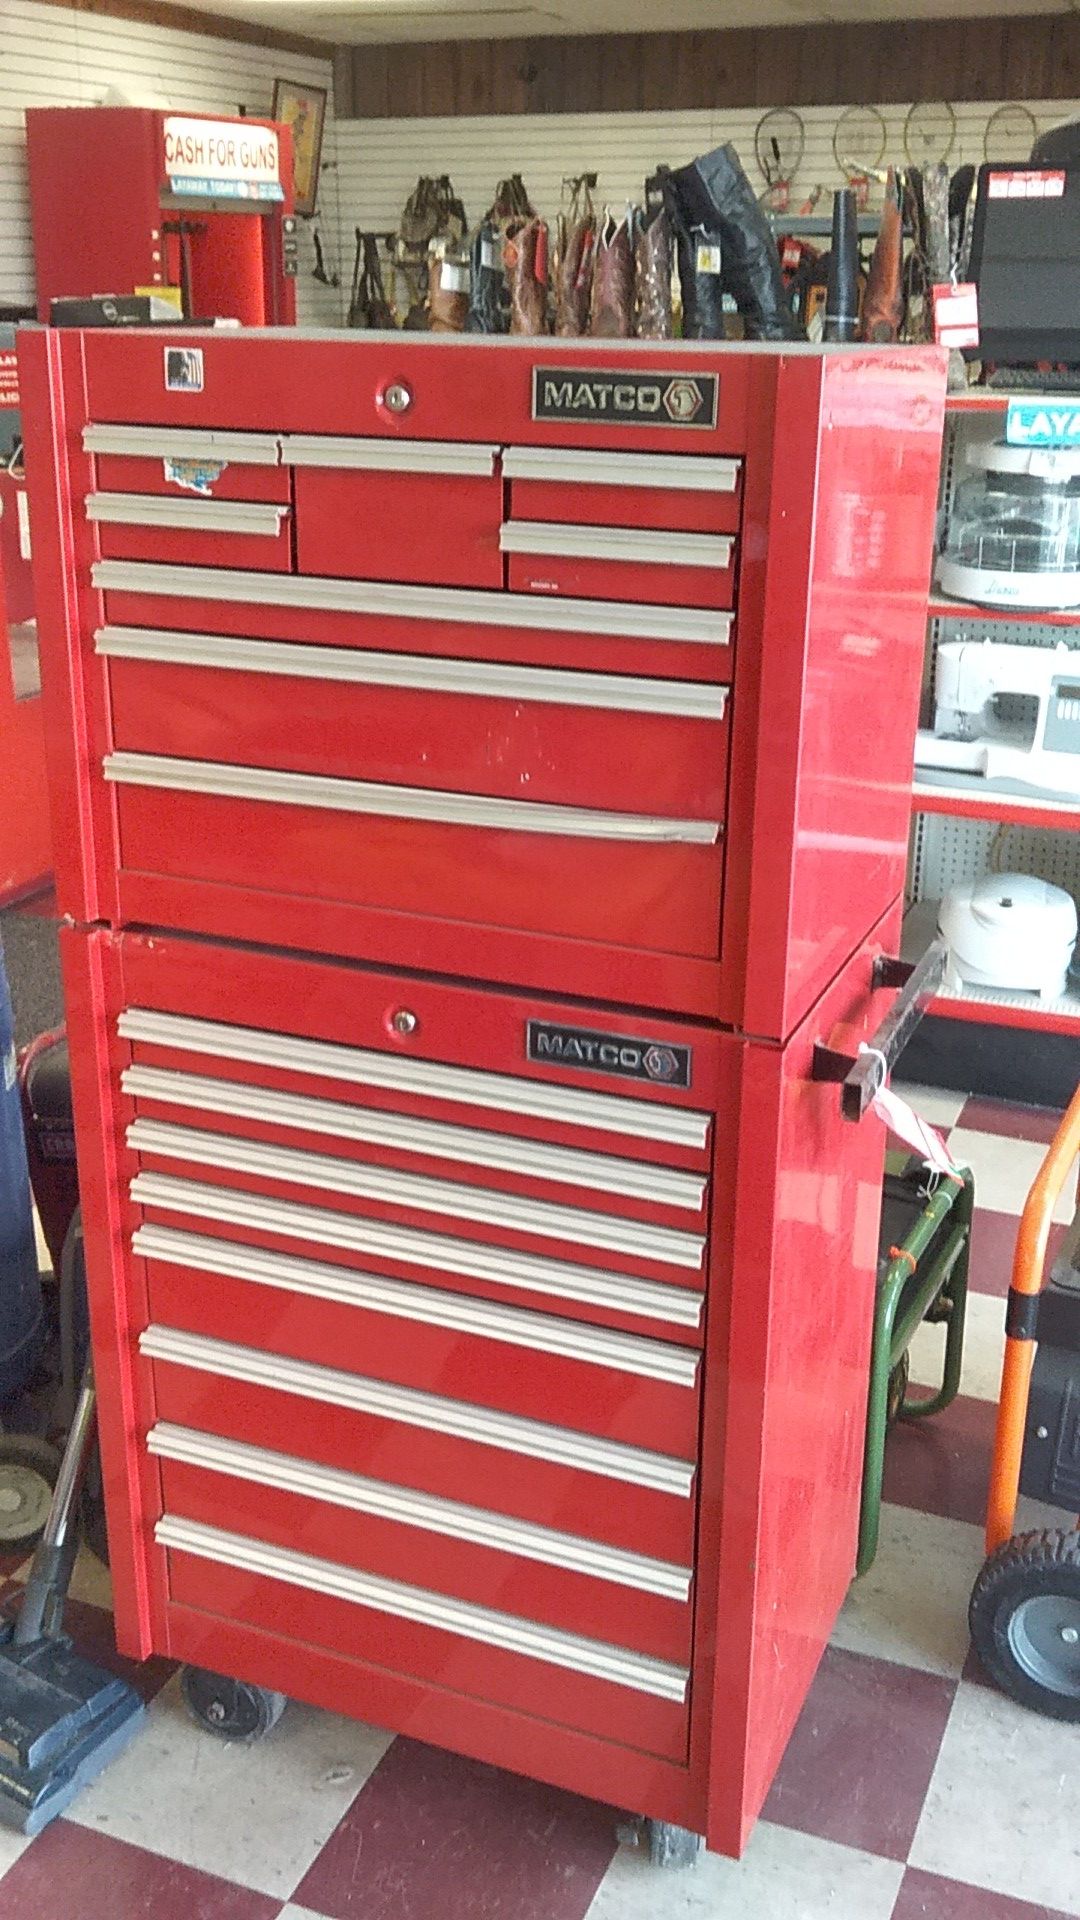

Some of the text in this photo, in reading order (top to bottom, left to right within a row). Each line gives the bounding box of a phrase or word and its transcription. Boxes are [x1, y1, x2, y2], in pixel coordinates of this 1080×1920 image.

[164, 132, 275, 170] CASH FOR GUNS
[544, 381, 661, 413] MATCO
[537, 1032, 642, 1069] MATCO
